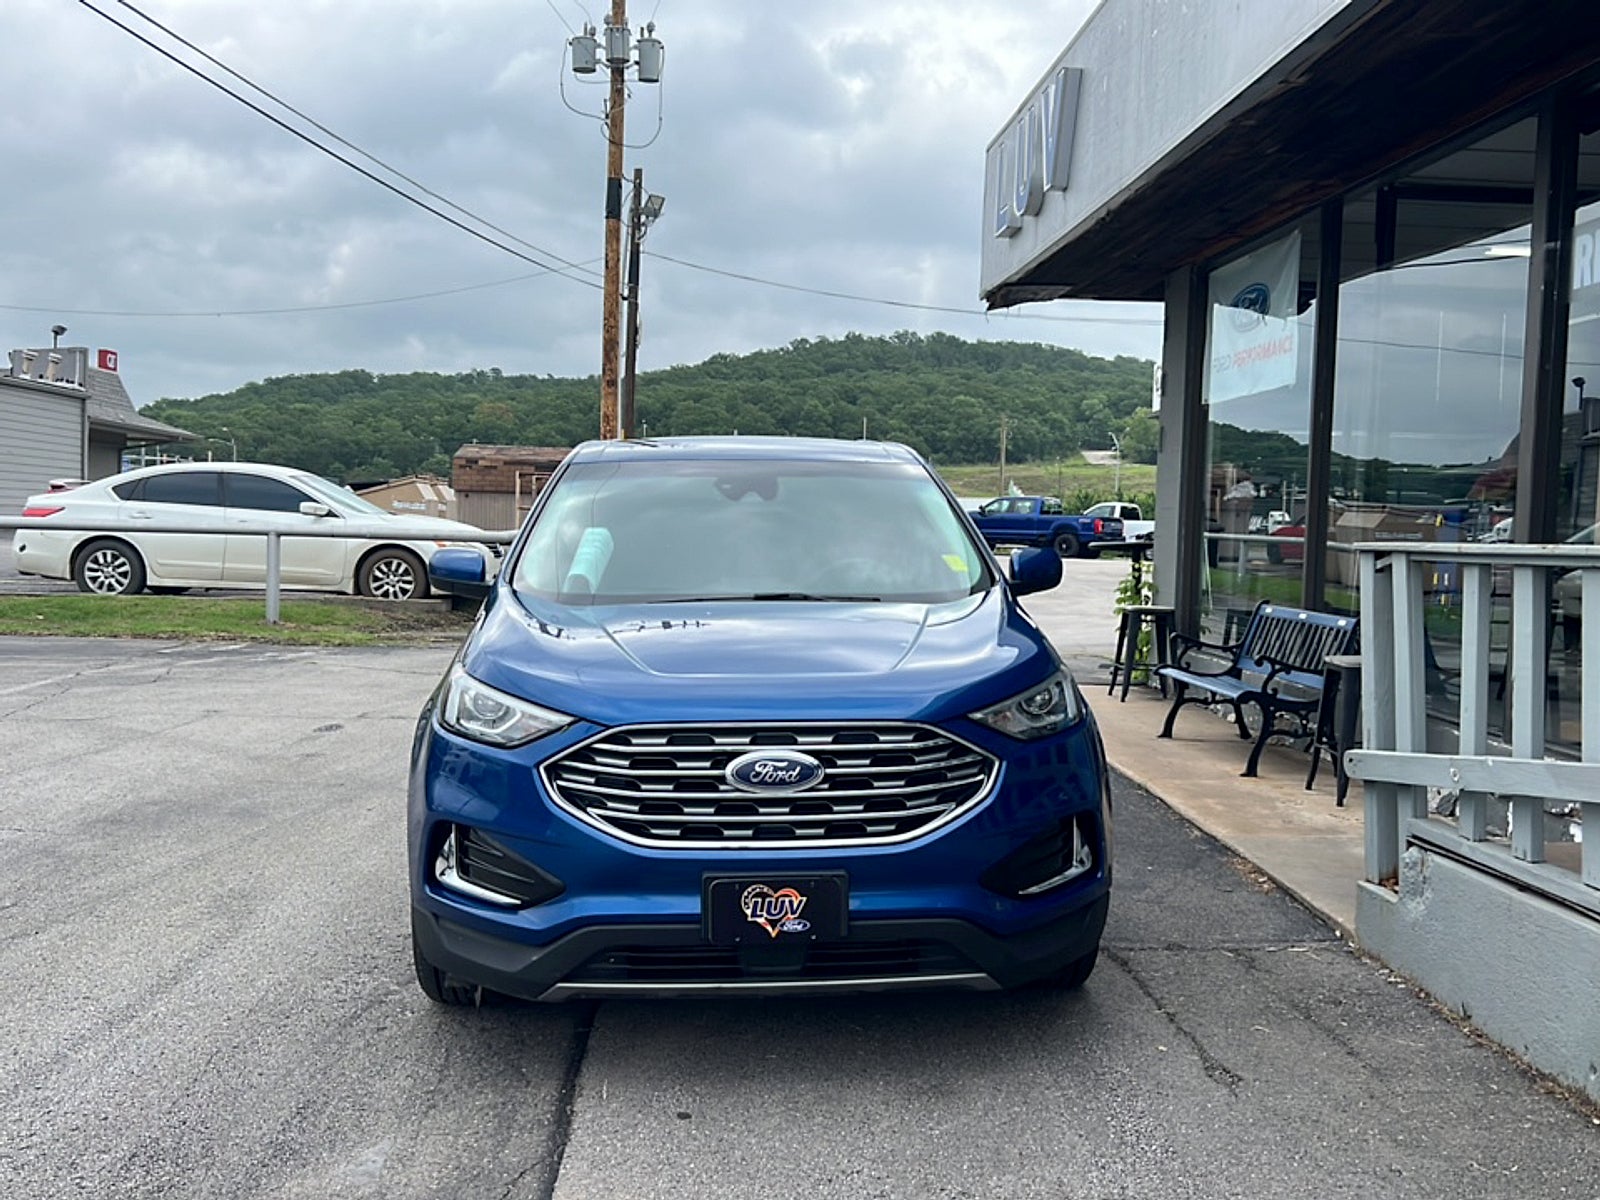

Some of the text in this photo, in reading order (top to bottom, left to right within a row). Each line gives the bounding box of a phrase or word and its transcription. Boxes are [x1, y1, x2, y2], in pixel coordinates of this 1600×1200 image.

[994, 67, 1083, 238] LUV
[749, 760, 801, 783] Ford
[747, 896, 807, 921] LUV
